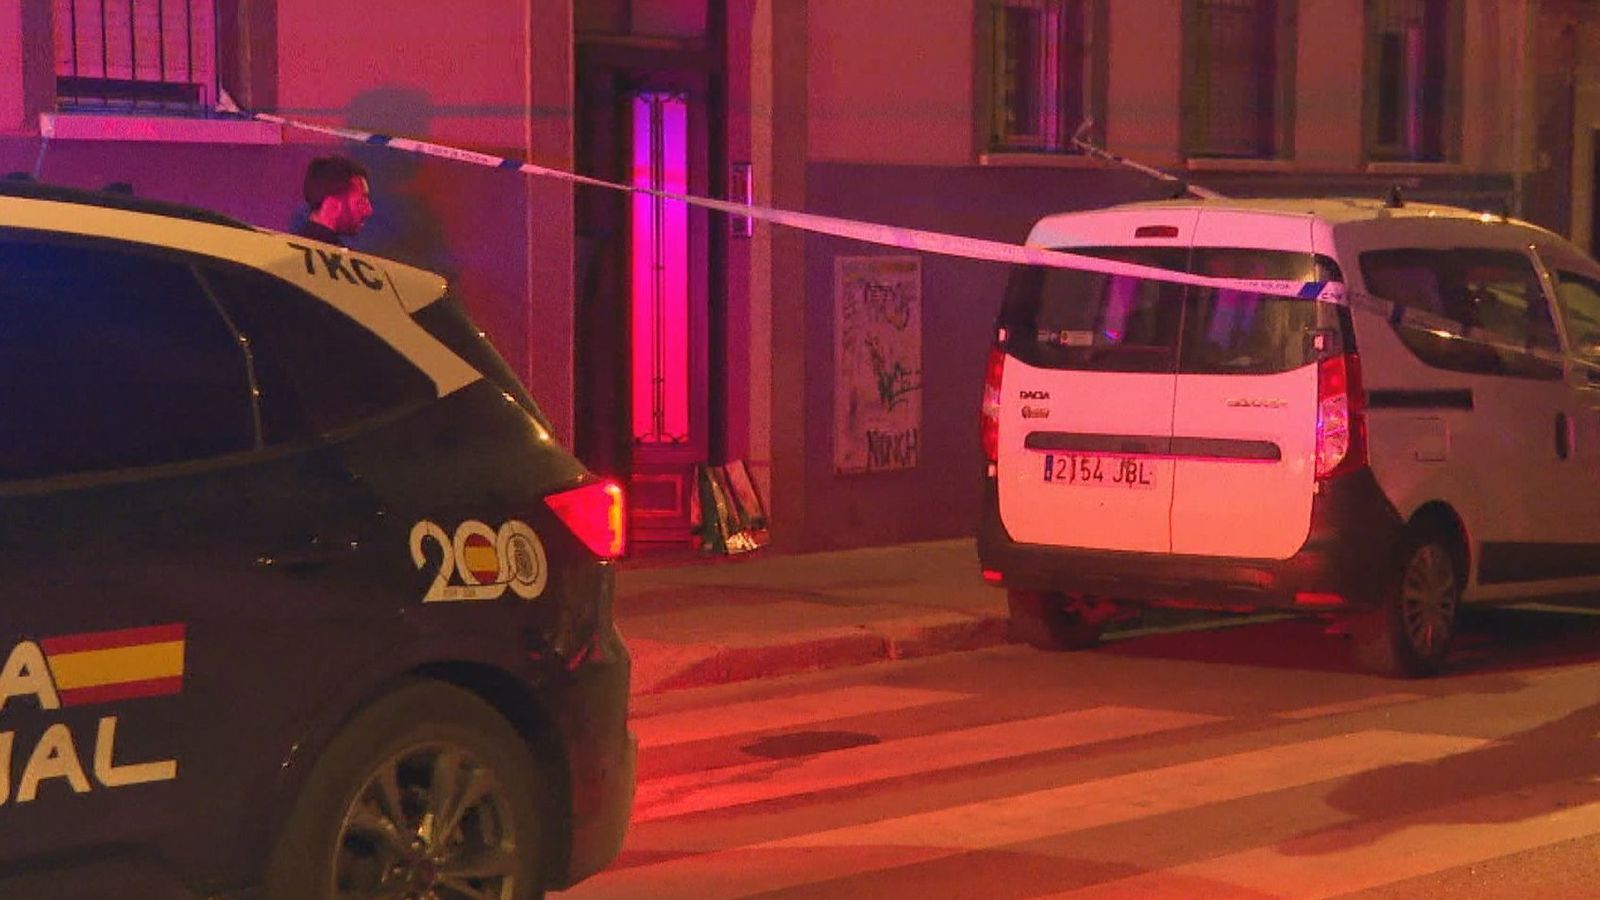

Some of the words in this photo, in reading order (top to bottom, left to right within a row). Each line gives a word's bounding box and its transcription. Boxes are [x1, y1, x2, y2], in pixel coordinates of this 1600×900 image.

[287, 241, 383, 290] 7KC
[1056, 456, 1104, 484] 2154
[1113, 460, 1151, 486] JBL
[409, 519, 548, 603] 200
